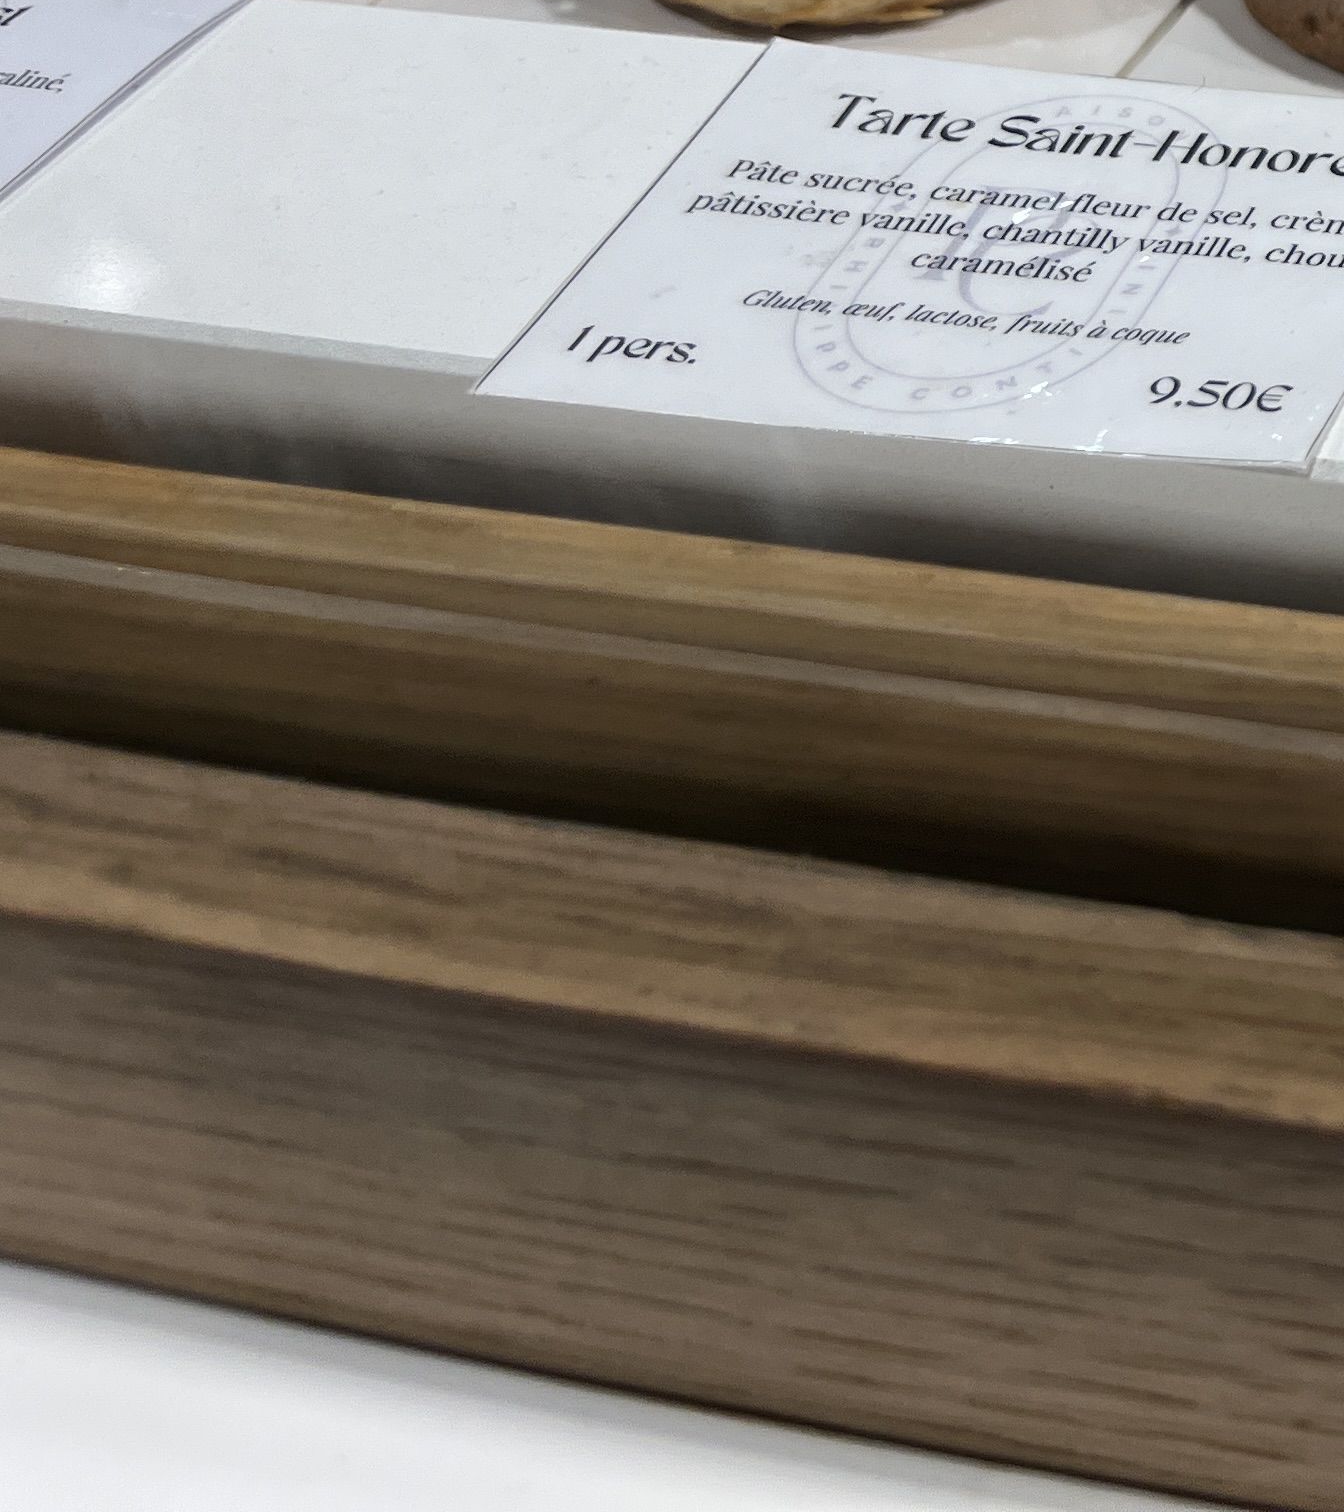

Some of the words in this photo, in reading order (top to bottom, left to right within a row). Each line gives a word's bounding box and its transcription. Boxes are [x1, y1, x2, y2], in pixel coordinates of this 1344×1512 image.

[830, 93, 977, 143] Tarte
[725, 159, 800, 185] Pâte
[802, 173, 917, 202] sucrée,
[929, 185, 1068, 212] caramel
[1066, 193, 1152, 219] fleur
[1154, 201, 1199, 224] de
[1200, 206, 1257, 230] sel,
[683, 190, 851, 226] pâtissière
[859, 212, 982, 242] vanille,
[981, 218, 1131, 255] chantilly
[1134, 230, 1251, 264] vanille,
[909, 244, 1095, 283] caramélisé
[742, 289, 833, 316] Gluten,
[903, 303, 999, 332] lactose,
[1002, 313, 1086, 338] fruits
[1085, 319, 1108, 339] à
[1110, 327, 1191, 346] coque
[566, 324, 596, 352] 1
[585, 335, 698, 365] pers.
[1149, 375, 1295, 414] 9.50€
